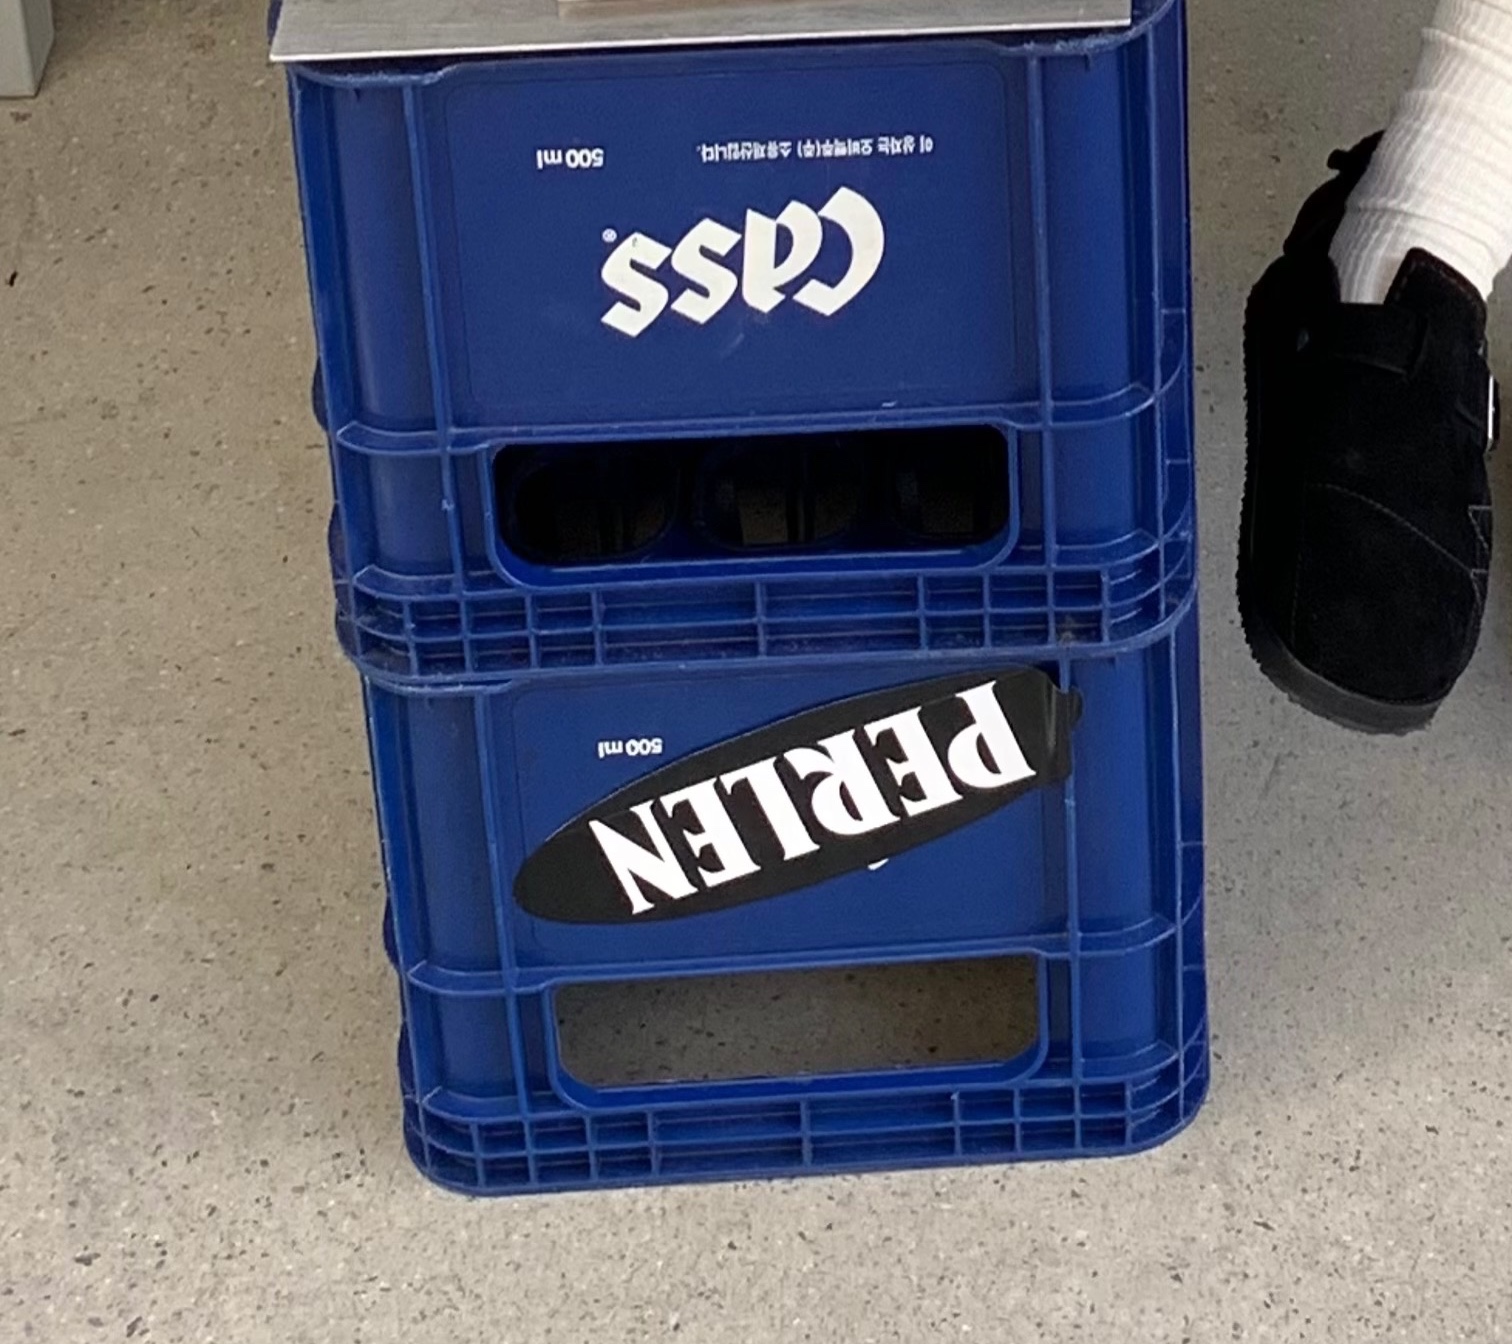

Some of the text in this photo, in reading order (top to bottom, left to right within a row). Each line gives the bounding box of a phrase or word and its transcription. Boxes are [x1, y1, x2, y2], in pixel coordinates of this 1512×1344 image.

[877, 135, 916, 155] 상자는
[919, 135, 934, 153] 이
[536, 147, 604, 170] 500 ml
[597, 737, 663, 760] 500 ml
[588, 680, 1036, 914] PERLEN
